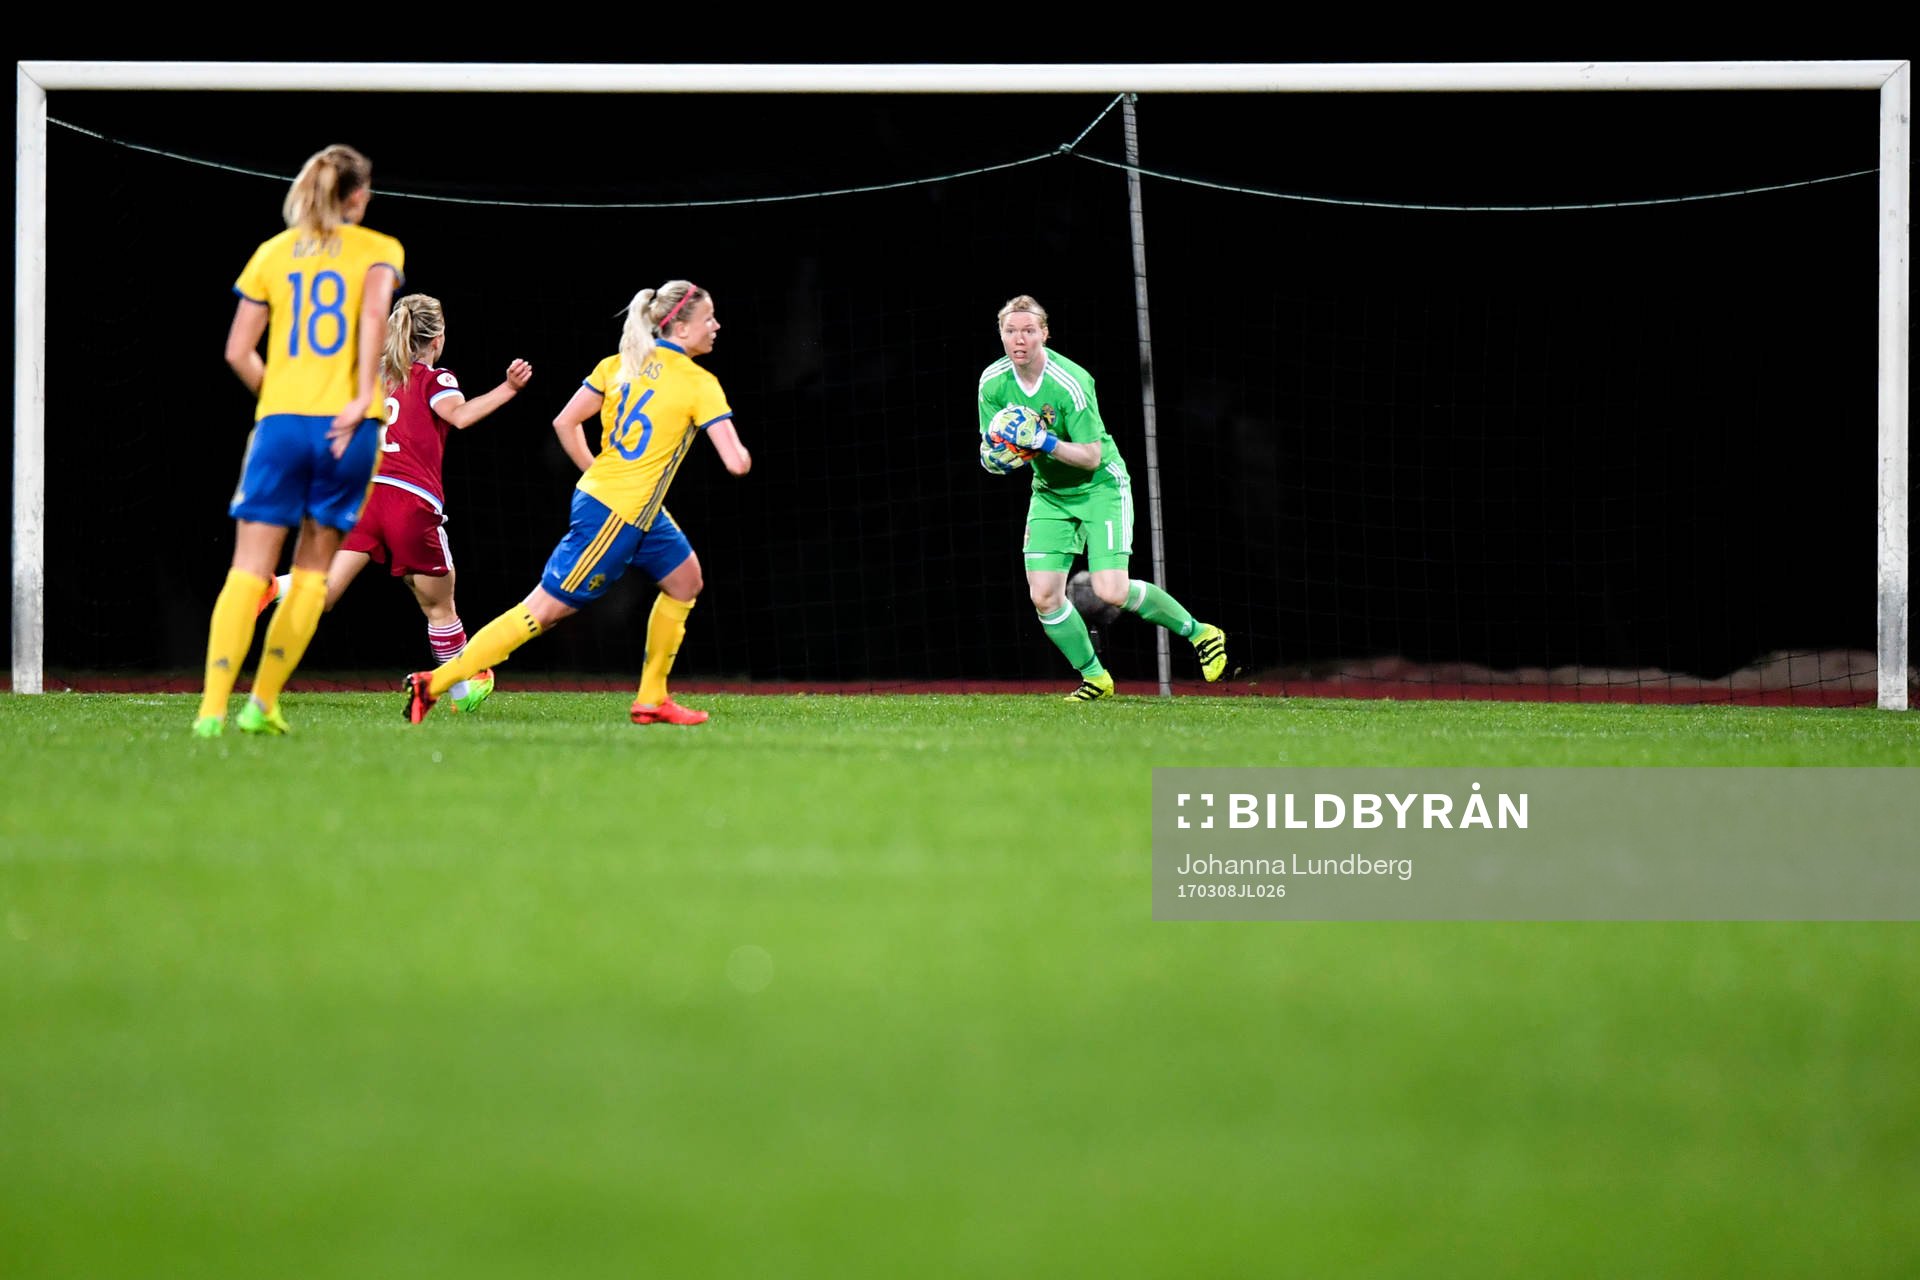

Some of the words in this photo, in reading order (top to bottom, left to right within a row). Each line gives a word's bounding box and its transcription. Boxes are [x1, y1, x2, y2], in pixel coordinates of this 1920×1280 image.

[288, 271, 347, 357] 18
[609, 382, 655, 461] 16
[1104, 520, 1114, 550] 1
